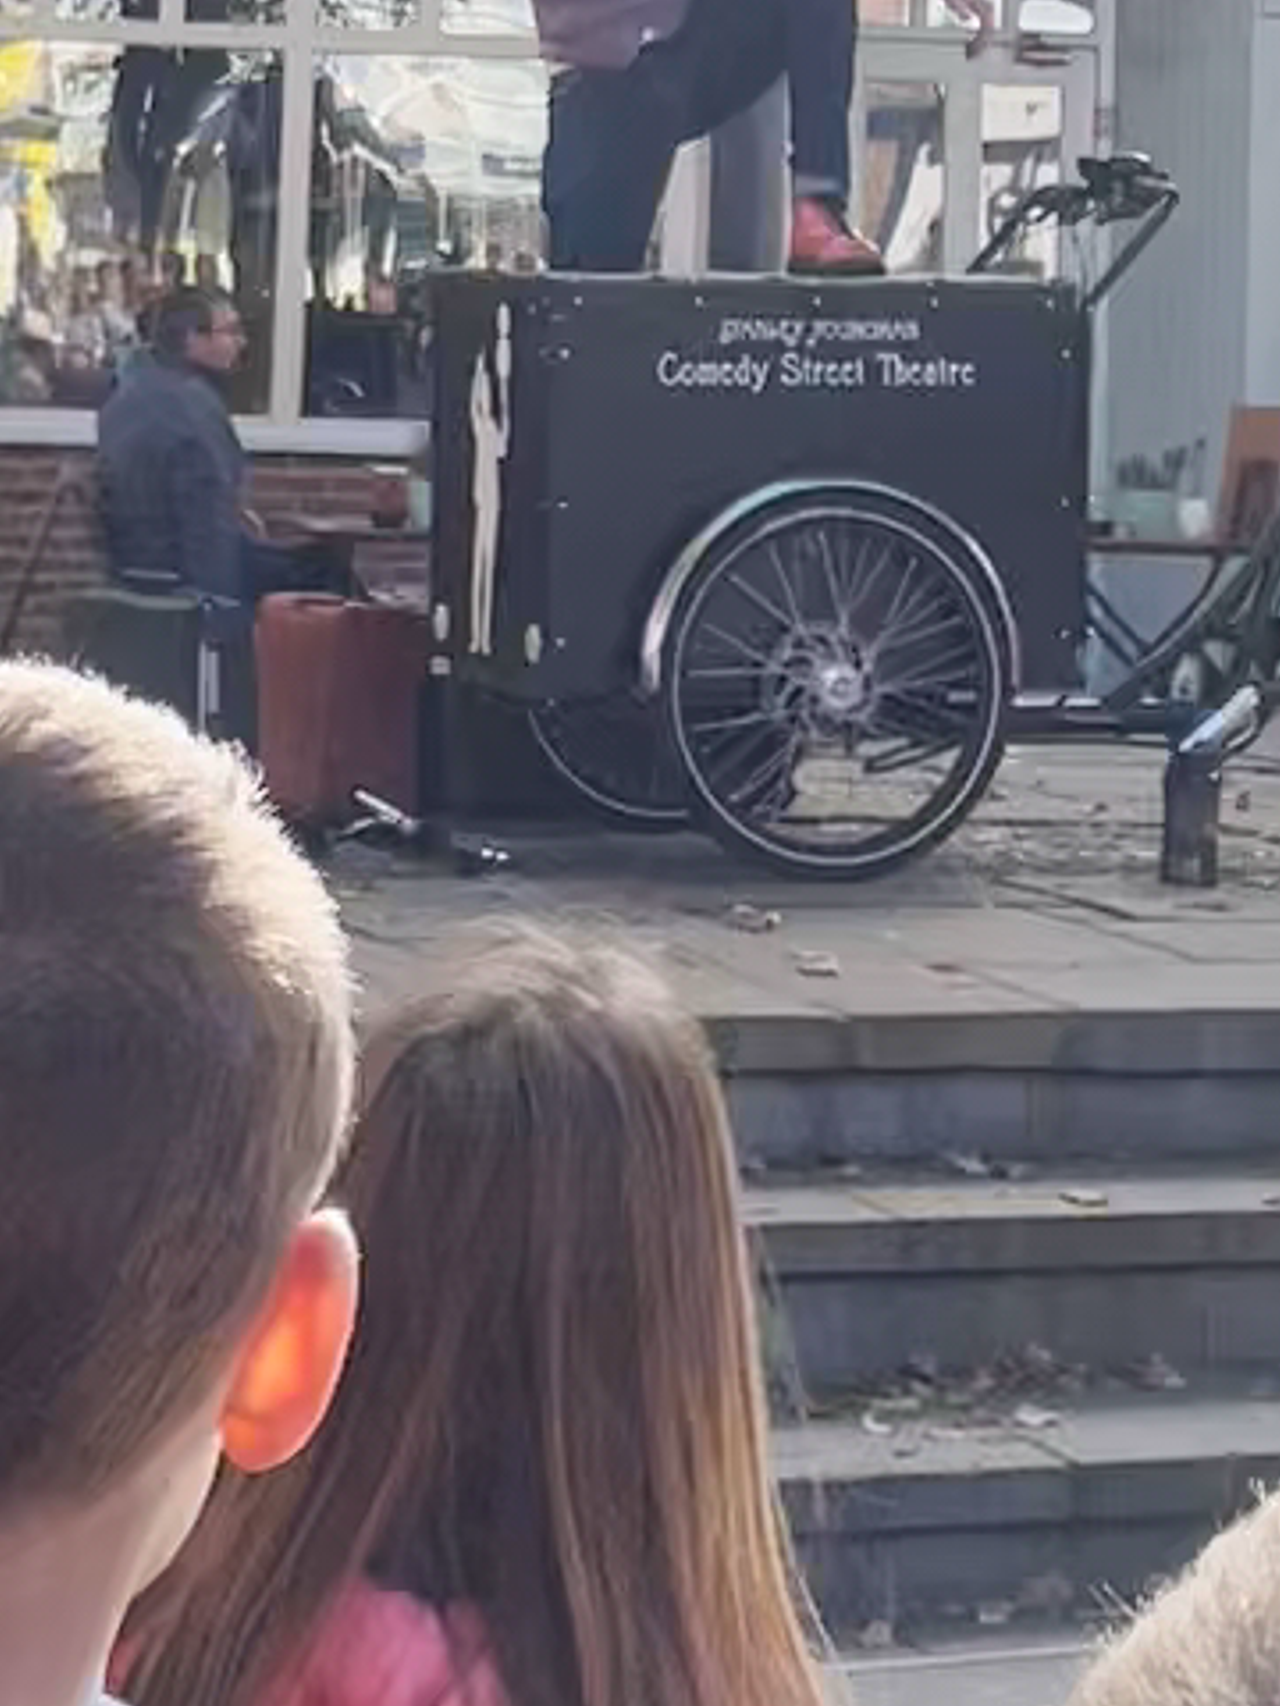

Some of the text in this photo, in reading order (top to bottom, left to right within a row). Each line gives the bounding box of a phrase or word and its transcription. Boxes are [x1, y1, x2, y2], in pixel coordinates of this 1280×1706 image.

[656, 351, 975, 393] Comedy Street Theatre
